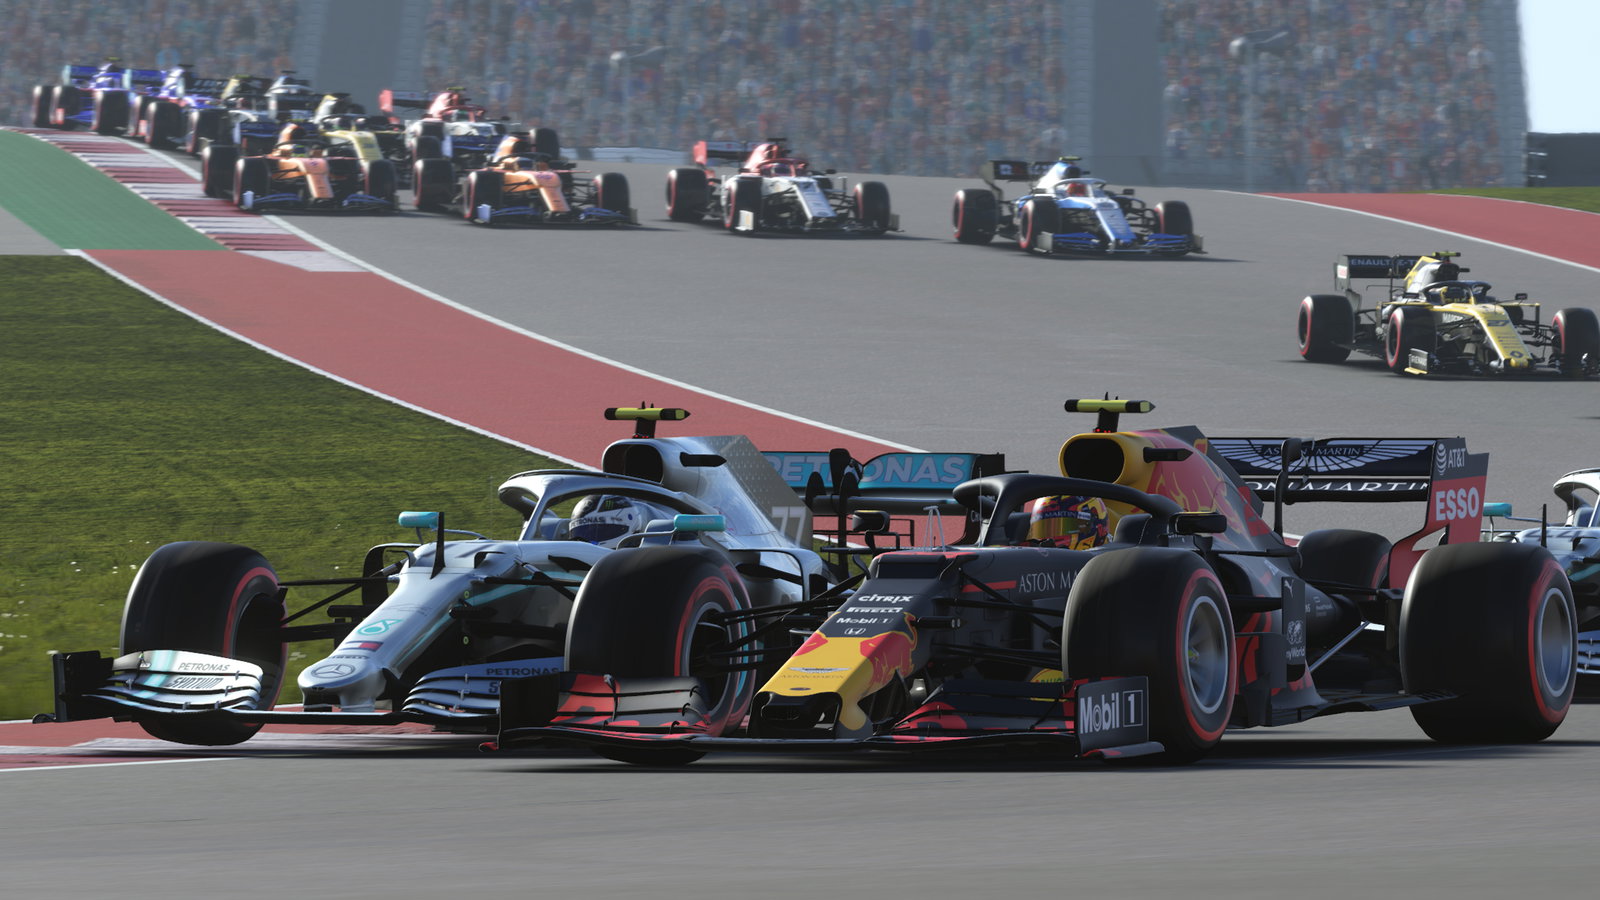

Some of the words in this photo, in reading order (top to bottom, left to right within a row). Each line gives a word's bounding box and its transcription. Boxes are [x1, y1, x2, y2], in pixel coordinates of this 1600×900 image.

[1264, 447, 1307, 456] ASN
[1315, 447, 1360, 456] MARTIN
[1448, 447, 1466, 469] AT&T
[767, 455, 965, 484] PETONAS
[1435, 486, 1480, 521] ESSO
[771, 505, 807, 547] 77
[1019, 571, 1056, 592] ASTON
[178, 662, 231, 672] PETRONAS
[1079, 691, 1121, 735] Mobil
[1127, 693, 1136, 724] 1
